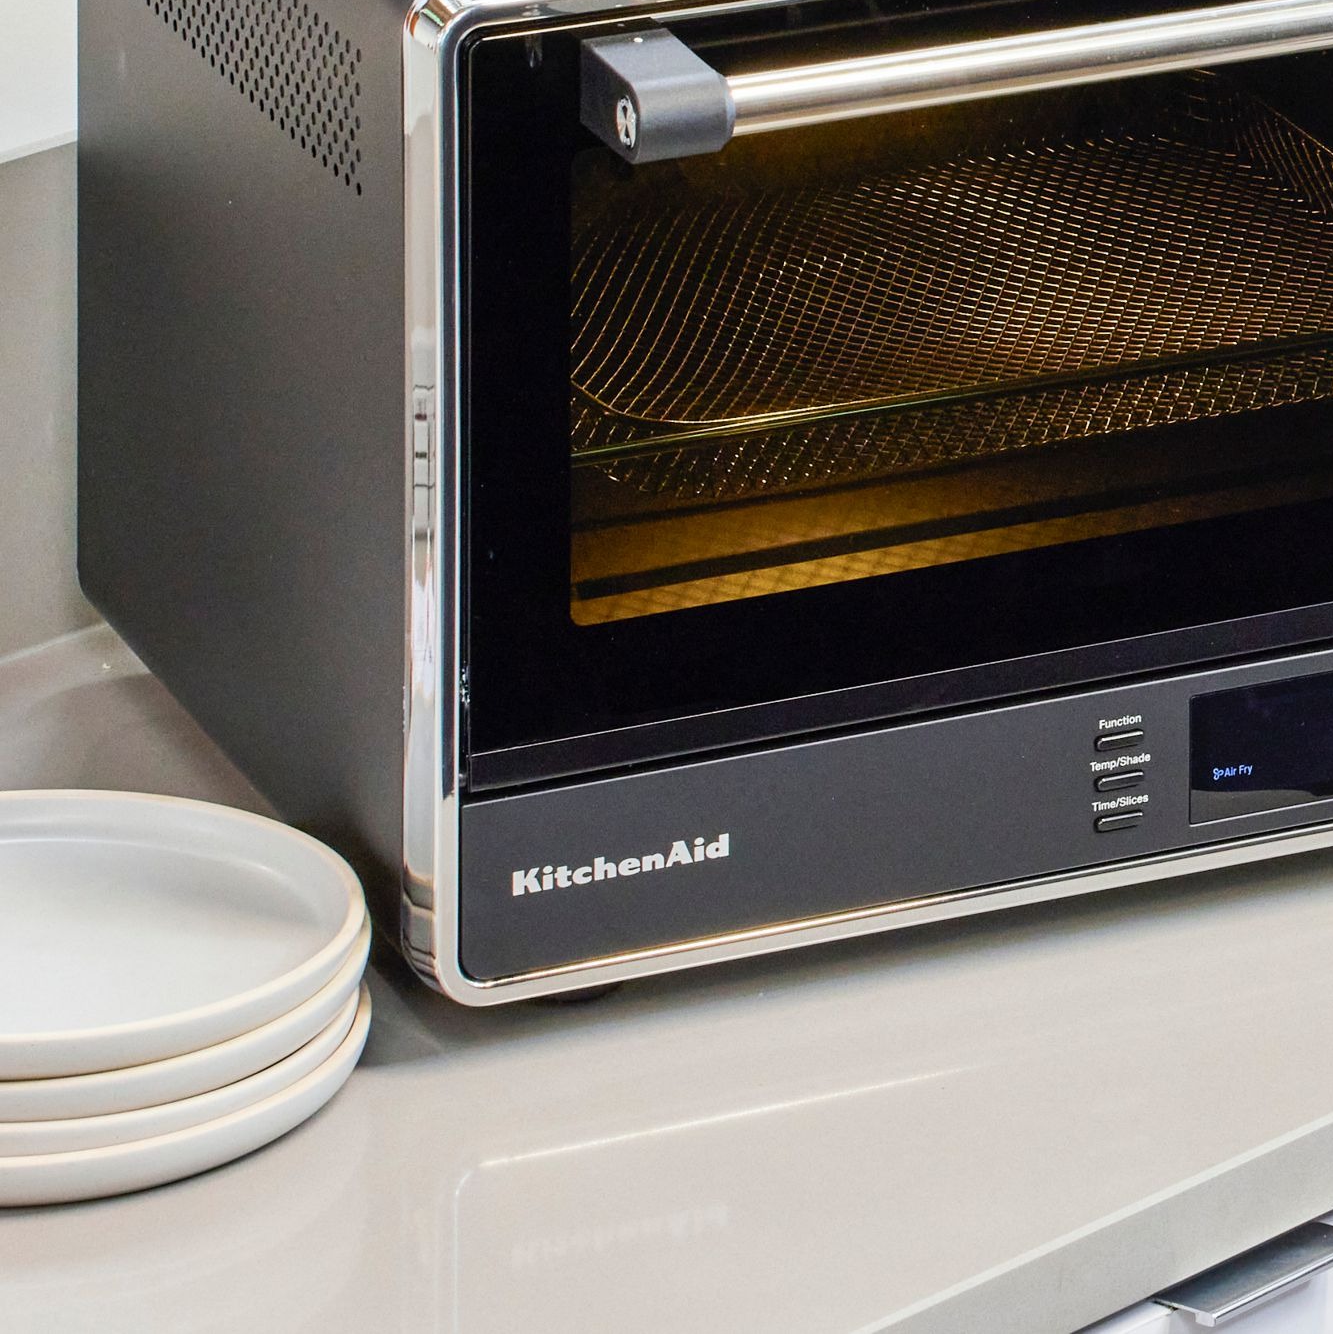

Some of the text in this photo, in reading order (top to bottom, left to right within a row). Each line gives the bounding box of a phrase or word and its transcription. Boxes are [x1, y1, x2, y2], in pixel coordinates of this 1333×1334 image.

[1099, 715, 1142, 730] Function
[1089, 752, 1151, 772] Temp/Shade
[1224, 765, 1253, 778] Air Fry
[1092, 794, 1149, 812] Time/Slices
[512, 833, 729, 896] KitchenAid
